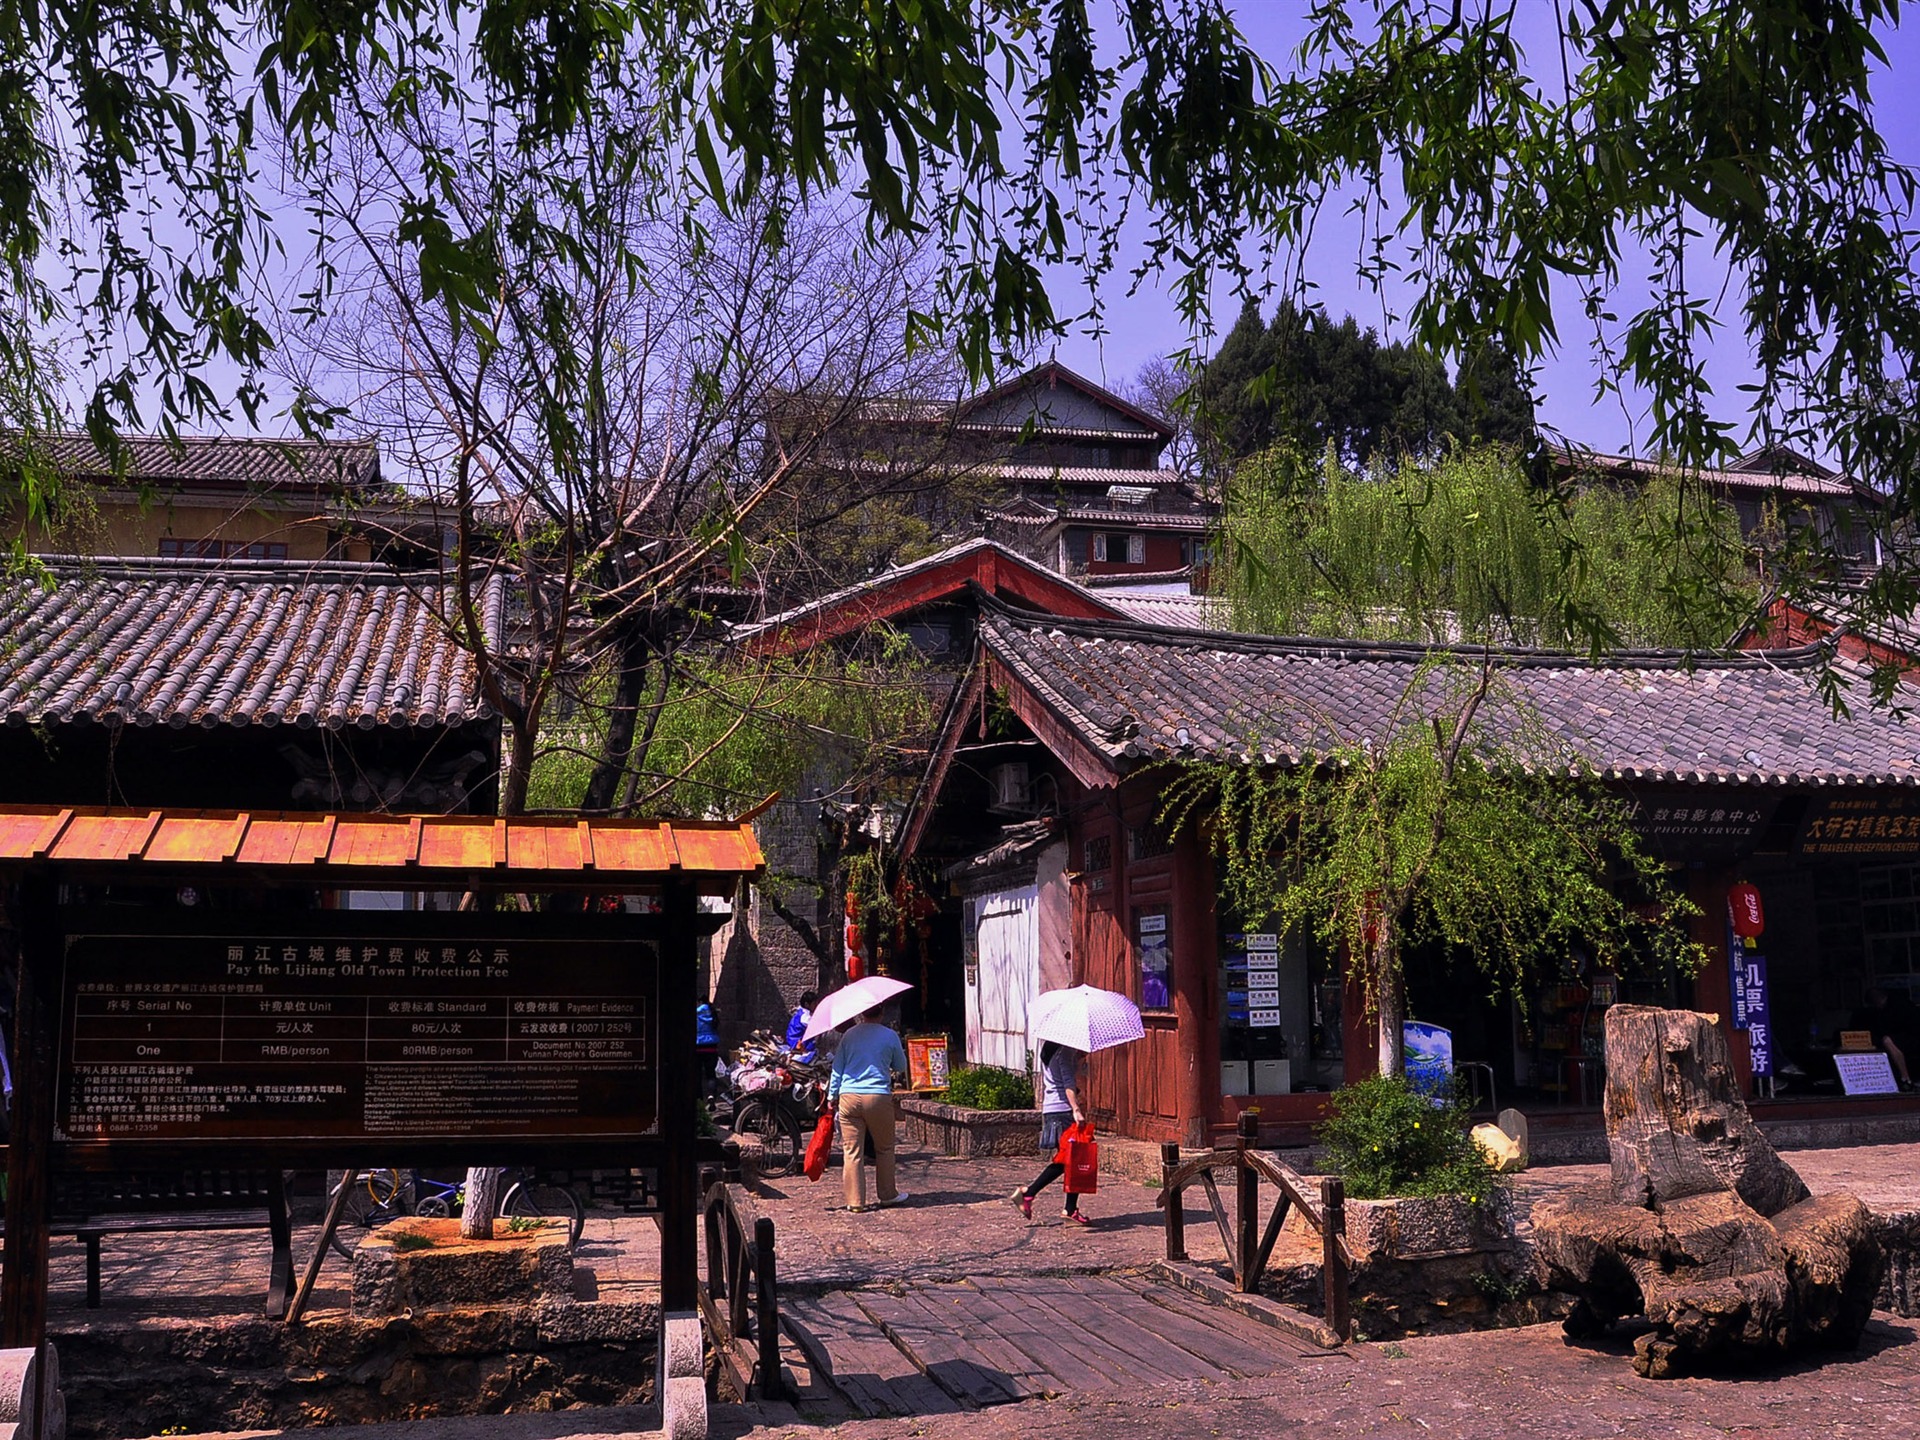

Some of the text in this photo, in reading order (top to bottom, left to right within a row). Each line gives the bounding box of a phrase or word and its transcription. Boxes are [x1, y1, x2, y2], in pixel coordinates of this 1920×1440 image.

[1653, 808, 1761, 823] 数码影像中心
[1654, 826, 1698, 835] PHOTO
[1702, 827, 1753, 835] SERVICE
[1802, 842, 1918, 853] THE TRAVELER RECEPTION CENTER
[227, 945, 510, 963] 丽江古城维护费收费公示
[227, 964, 510, 978] Pay the Lijiang Old Town Protection Fee
[106, 1000, 192, 1011] 序号 Serial No
[259, 1001, 332, 1012] 计费单位 Unit
[389, 1001, 487, 1013] 收费标准 Standard
[514, 1001, 635, 1014] 收费依据 Payment Evidence
[146, 1023, 152, 1032] 1
[276, 1022, 314, 1034] 元/人次
[411, 1022, 462, 1035] 80元/人次
[136, 1045, 161, 1055] One
[261, 1045, 330, 1058] RMB/person
[402, 1045, 473, 1057] 80RMB/person
[533, 1041, 572, 1050] Document
[610, 1042, 625, 1050] 252
[522, 1050, 552, 1059] Yunnan
[553, 1050, 586, 1060] People's
